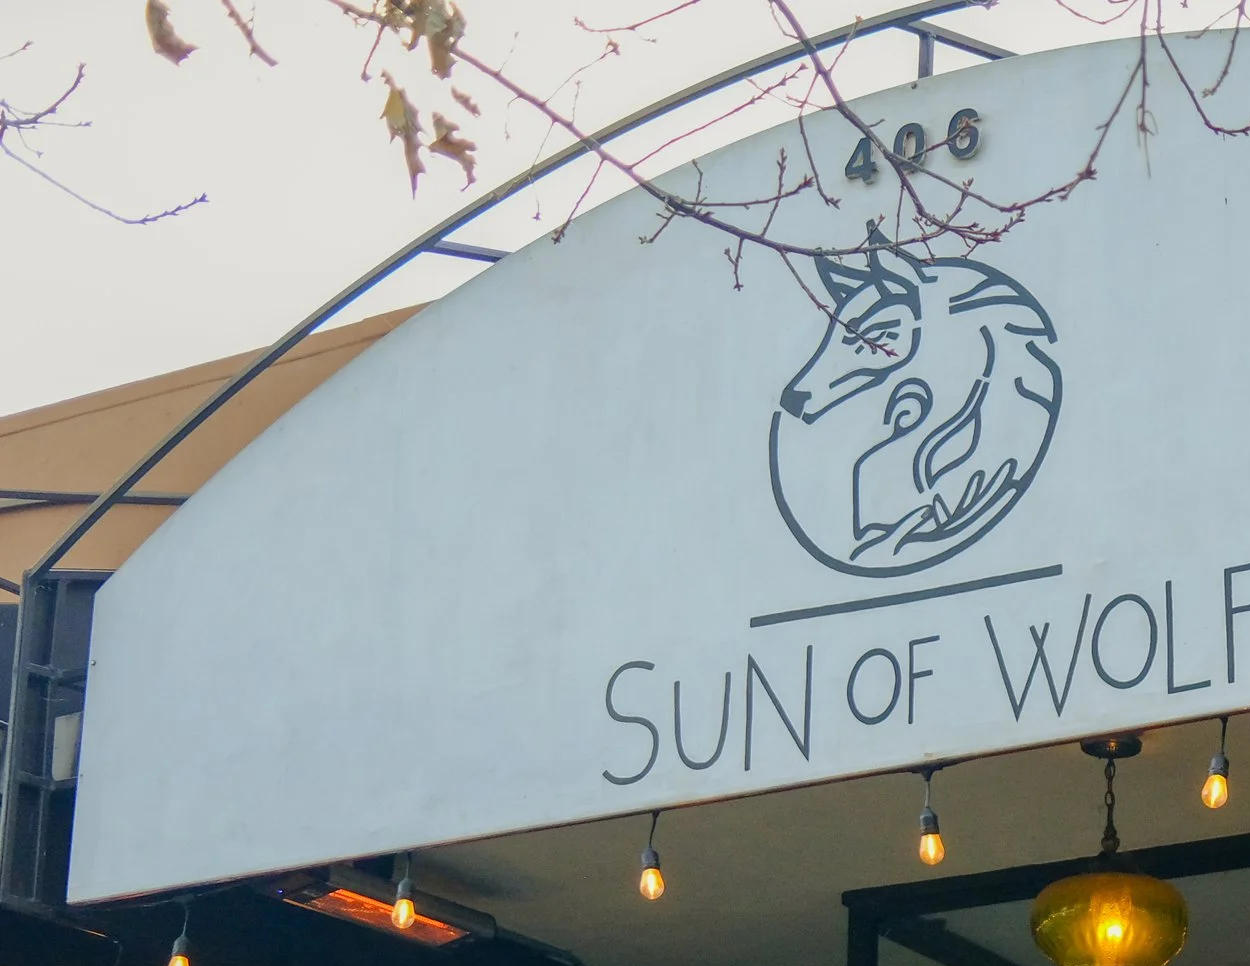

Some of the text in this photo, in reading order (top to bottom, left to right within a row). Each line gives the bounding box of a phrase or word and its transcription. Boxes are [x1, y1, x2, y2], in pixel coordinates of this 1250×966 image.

[844, 107, 982, 185] 406
[602, 644, 813, 786] SUN
[846, 635, 940, 725] OF
